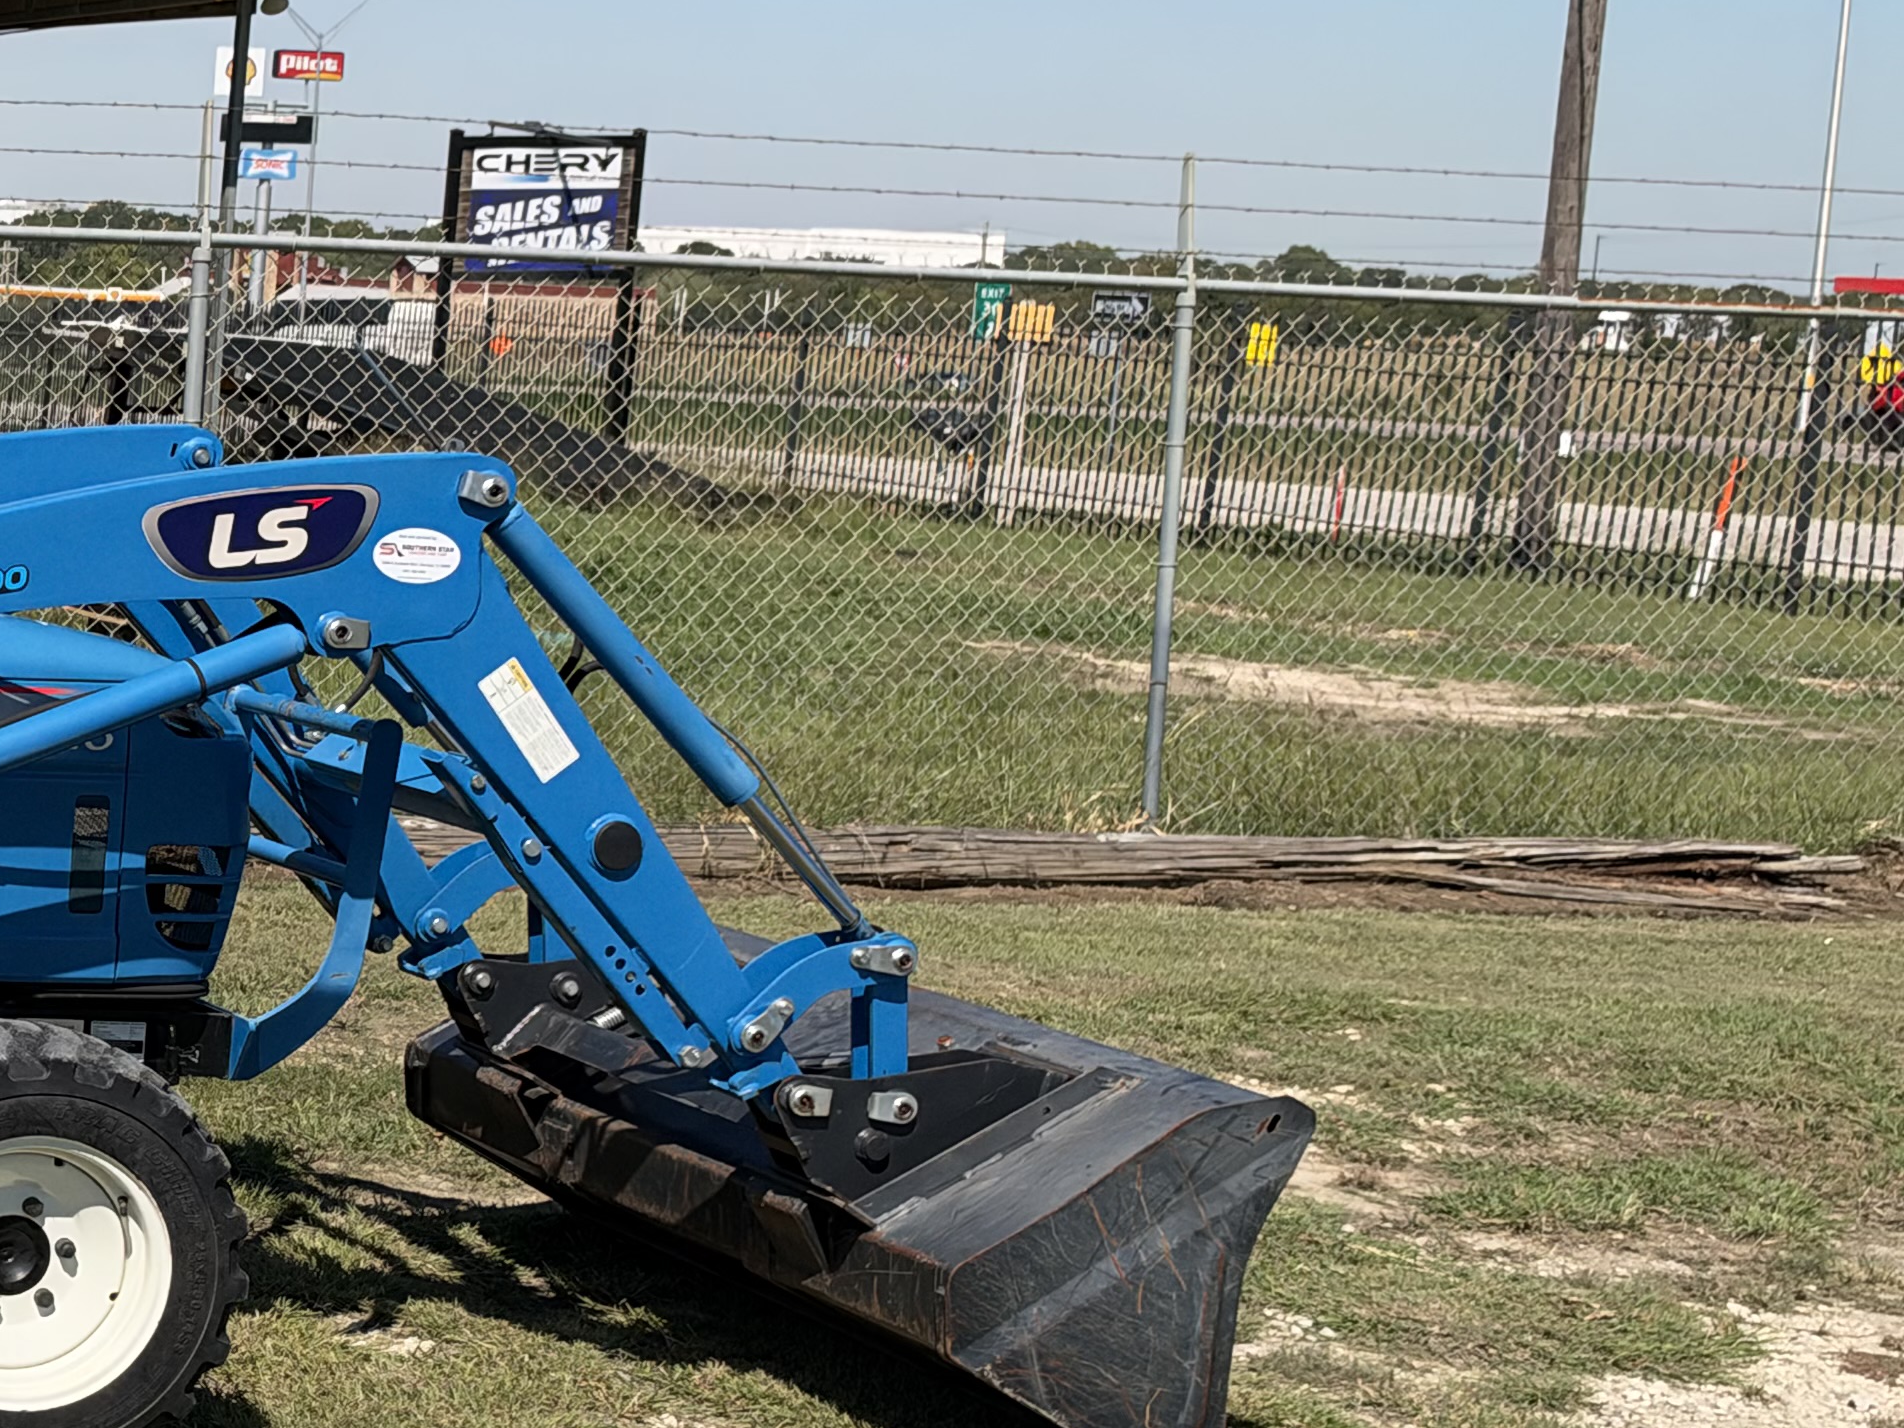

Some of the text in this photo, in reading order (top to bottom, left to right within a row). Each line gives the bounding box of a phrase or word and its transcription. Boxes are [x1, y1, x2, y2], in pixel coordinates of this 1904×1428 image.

[476, 152, 620, 173] CHERY
[473, 194, 604, 236] SALES AND
[207, 504, 309, 570] LS
